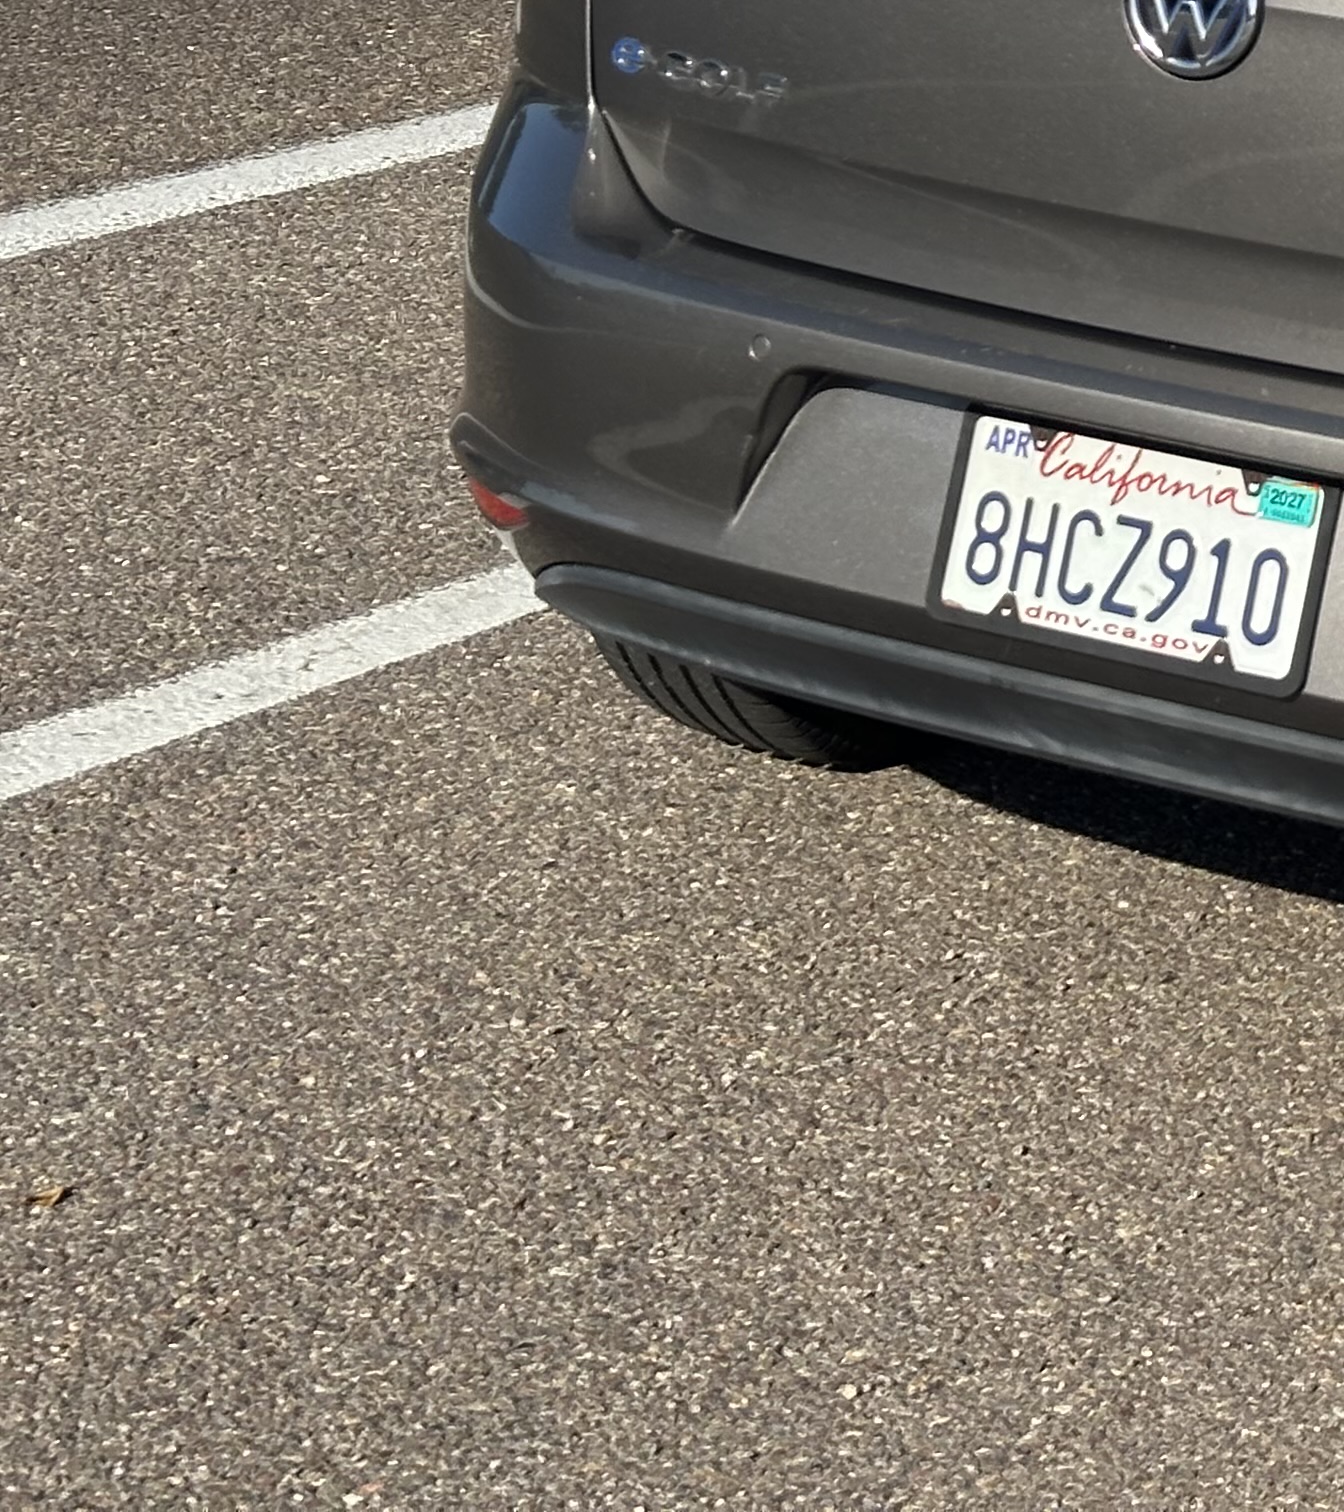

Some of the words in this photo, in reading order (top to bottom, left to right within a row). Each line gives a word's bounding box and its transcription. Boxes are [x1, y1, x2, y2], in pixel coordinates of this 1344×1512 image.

[985, 425, 1031, 458] APR
[1039, 432, 1259, 517] California
[1269, 488, 1307, 510] 2027
[965, 490, 1289, 646] 8HCZ910
[1025, 605, 1208, 655] dmv.ca.gov
